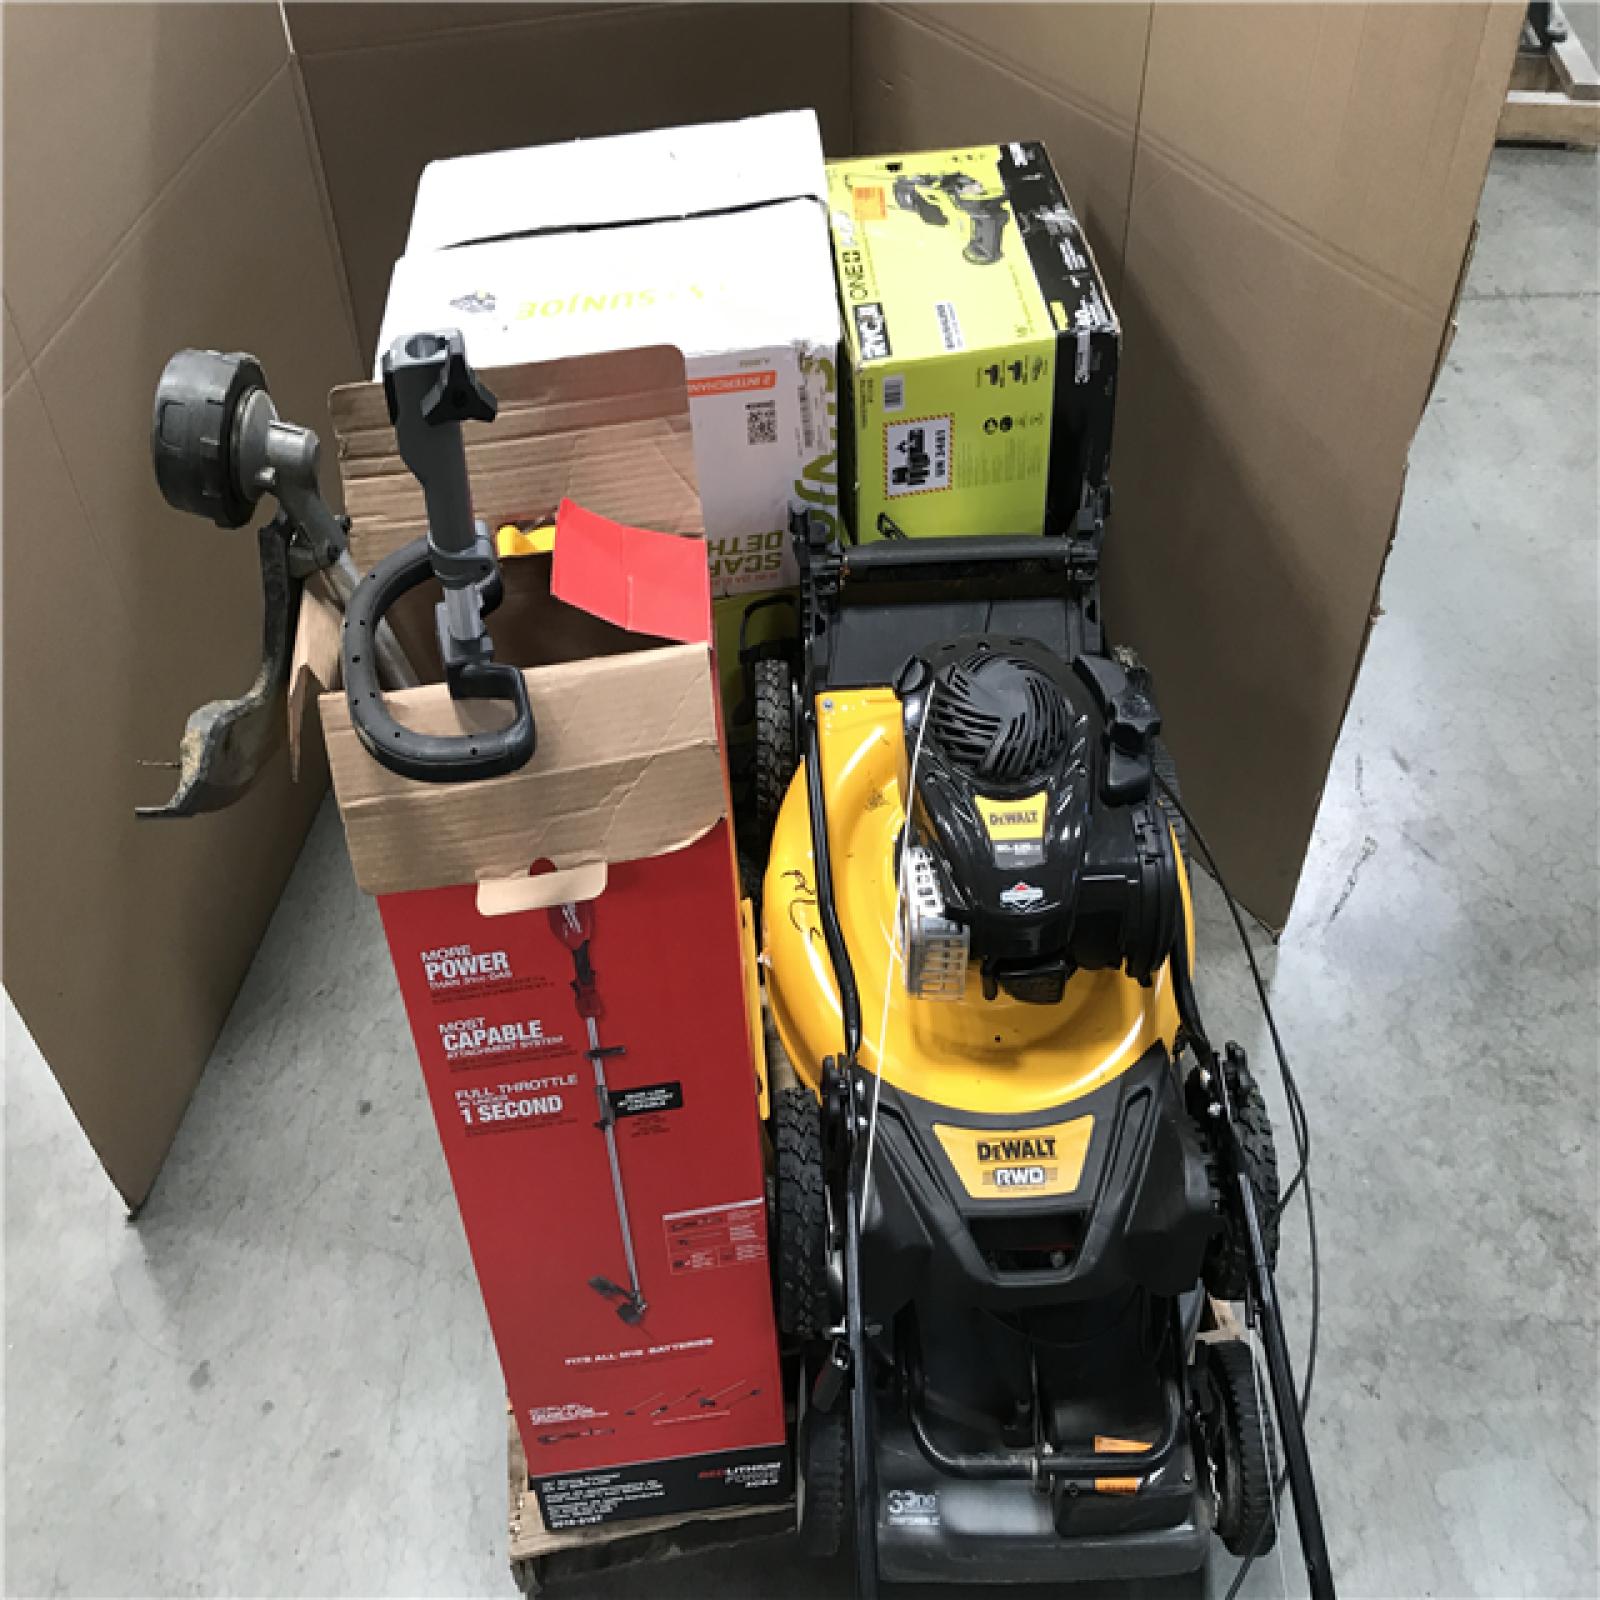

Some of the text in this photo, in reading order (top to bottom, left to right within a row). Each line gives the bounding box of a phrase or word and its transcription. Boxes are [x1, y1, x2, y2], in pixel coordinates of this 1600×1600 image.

[420, 944, 471, 963] MORE
[424, 950, 509, 982] POWER
[438, 1016, 486, 1034] MOST
[443, 1019, 544, 1052] CAPABLE
[454, 1072, 579, 1101] FULL THROTTLE
[459, 1106, 473, 1126] 1
[478, 1094, 564, 1122] SECOND
[995, 1166, 1045, 1187] RWD
